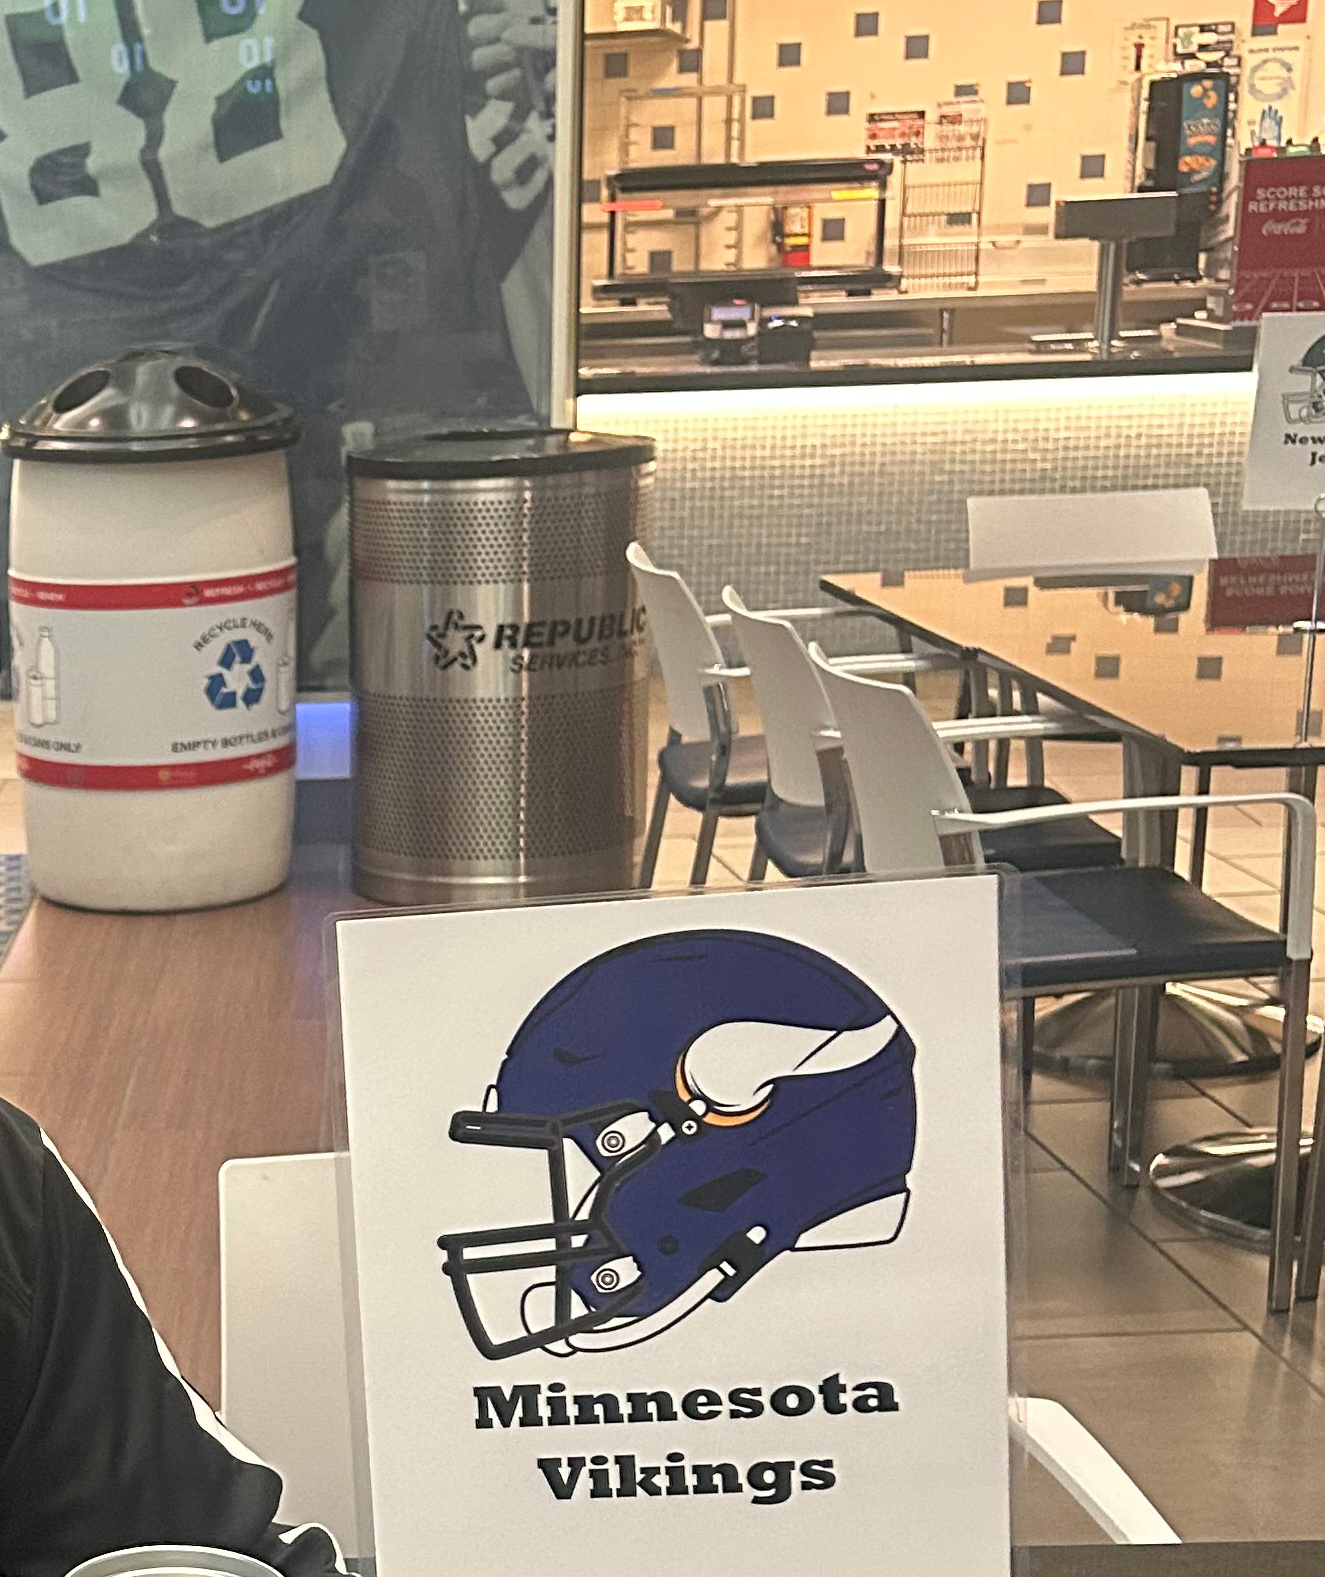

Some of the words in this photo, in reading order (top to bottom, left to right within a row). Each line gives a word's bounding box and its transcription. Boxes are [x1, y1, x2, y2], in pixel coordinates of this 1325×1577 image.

[1256, 186, 1308, 200] SCORE
[193, 617, 248, 652] RECYCLE
[494, 604, 646, 651] REPUBLIC
[171, 740, 218, 753] EMPTY
[221, 732, 269, 749] BOTTLES
[473, 1373, 900, 1429] Minnesota
[537, 1453, 837, 1505] Vikings
